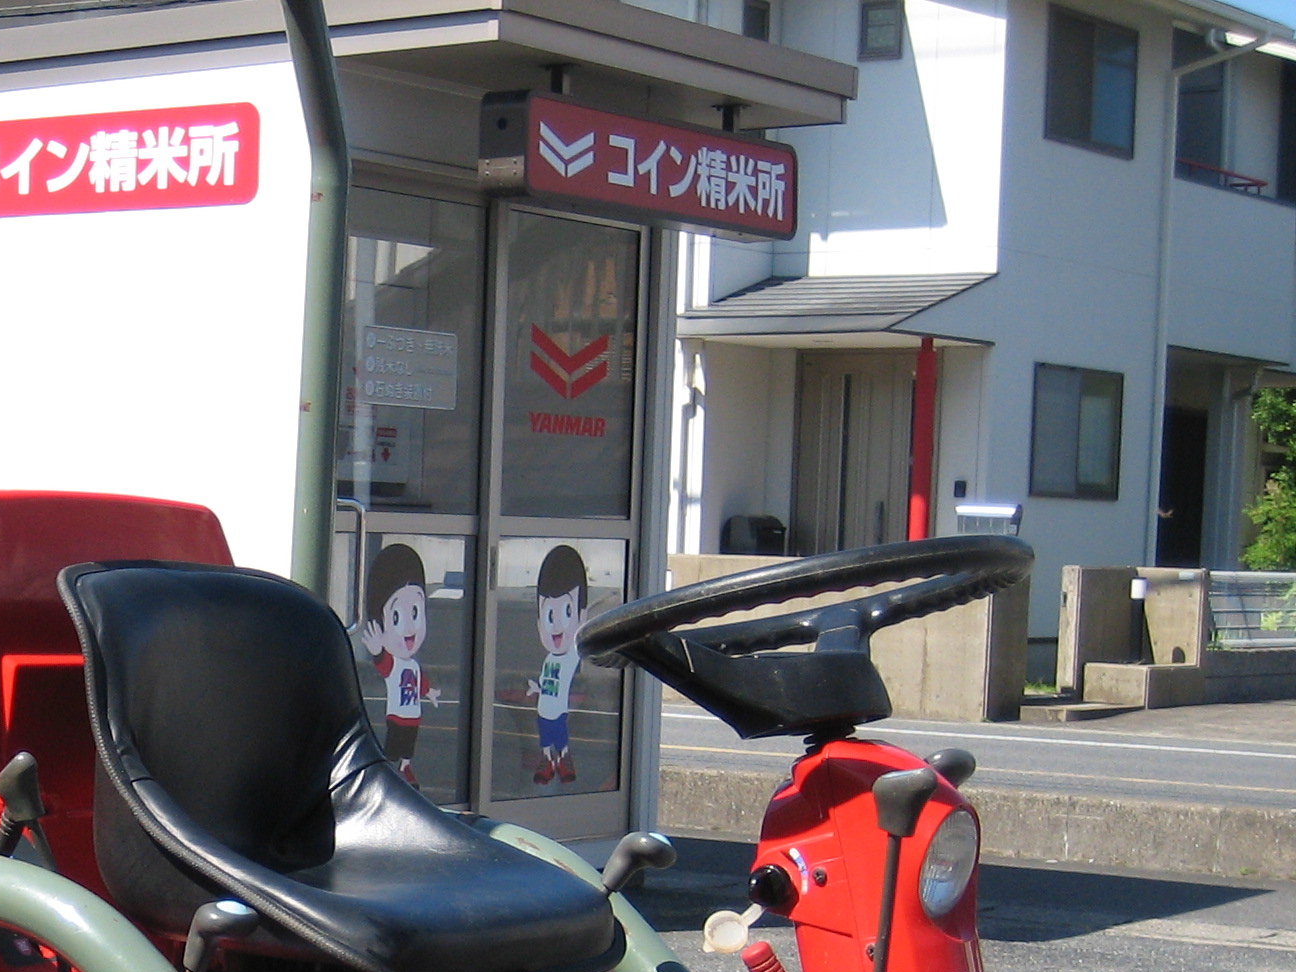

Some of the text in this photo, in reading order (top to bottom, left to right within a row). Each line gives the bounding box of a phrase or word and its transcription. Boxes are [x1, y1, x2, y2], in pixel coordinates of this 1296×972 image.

[607, 133, 786, 221] コイン精米所
[529, 411, 606, 437] YANMAR
